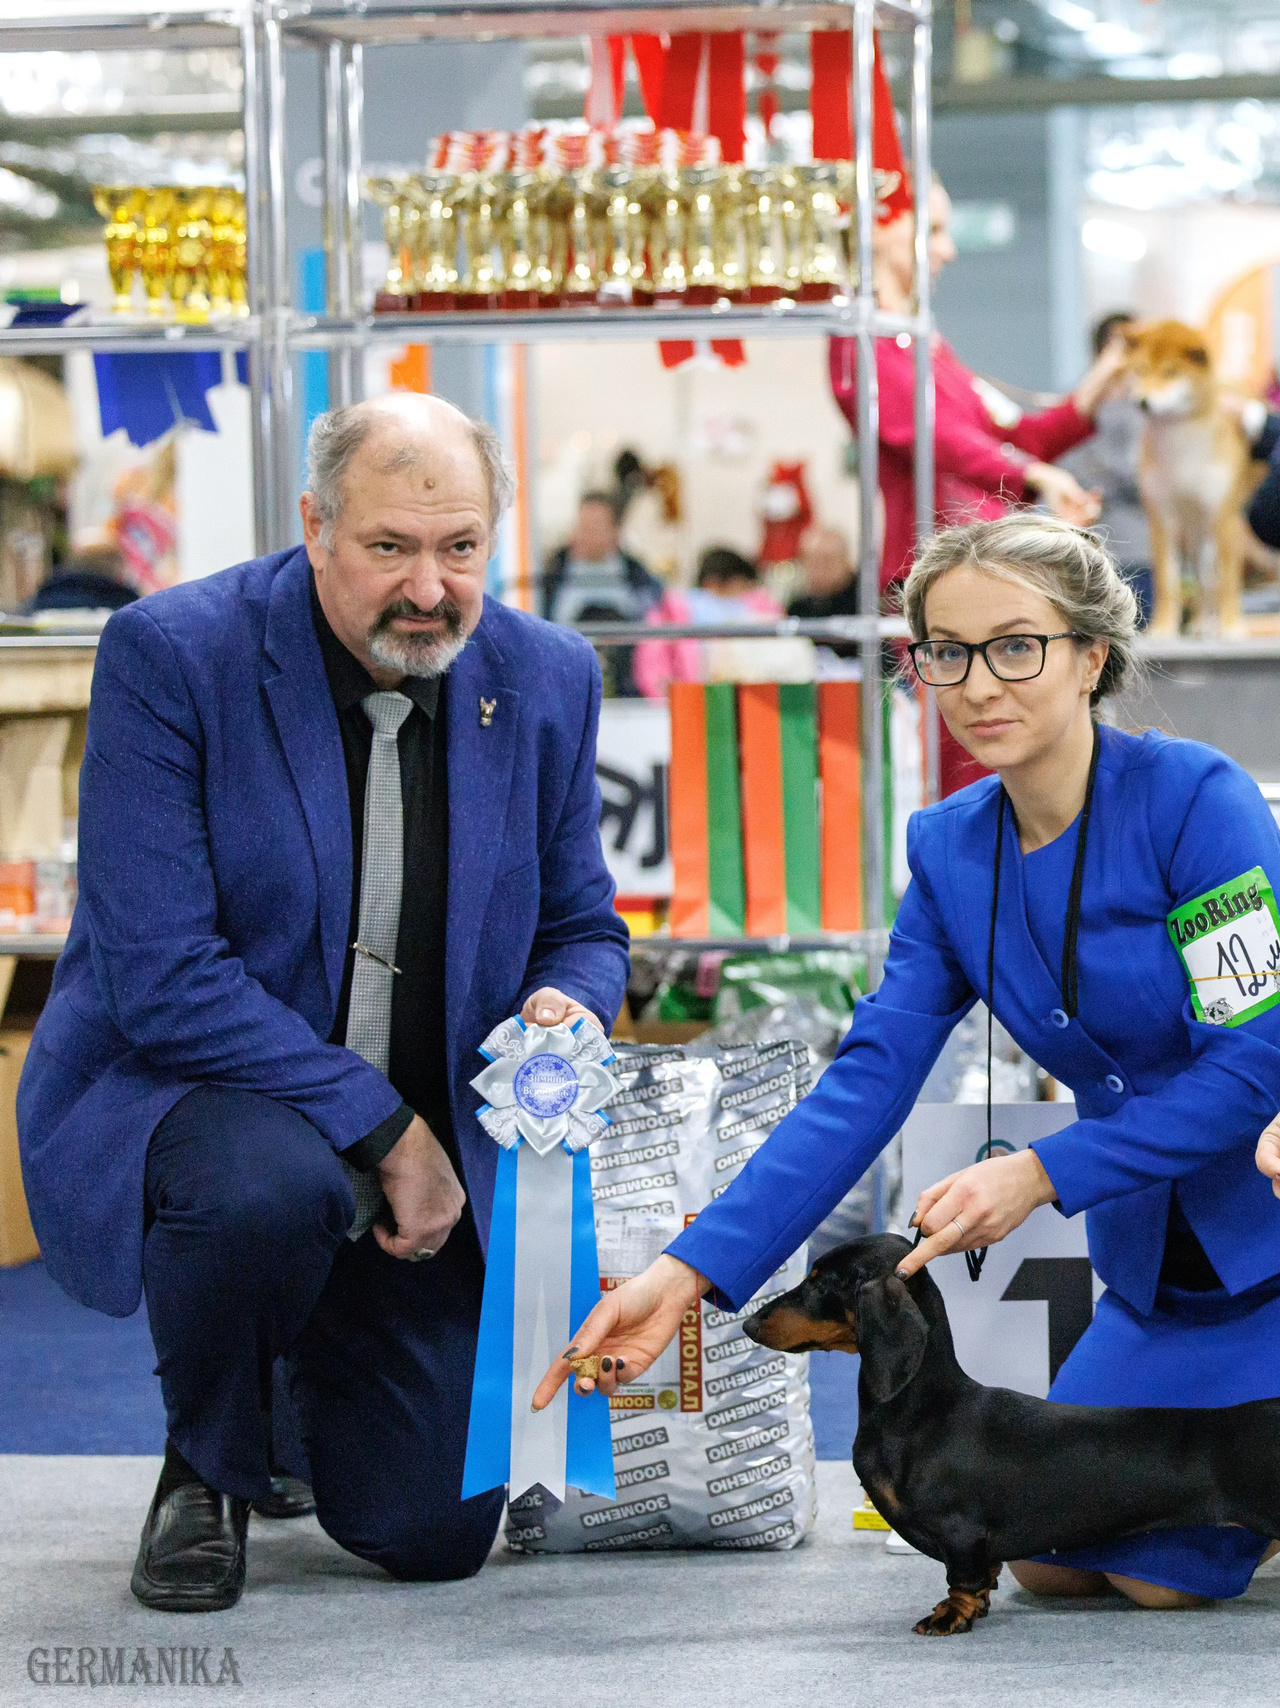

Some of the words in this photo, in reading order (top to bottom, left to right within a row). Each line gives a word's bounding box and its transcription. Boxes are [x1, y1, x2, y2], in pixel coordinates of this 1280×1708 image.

[1170, 883, 1265, 945] ZooRing
[590, 1142, 678, 1171] ЗООМЕНЮ
[681, 1302, 700, 1410] СИОНАЛ
[707, 1358, 786, 1395] ЗООМЕНЮ
[609, 1396, 654, 1408] ЗООМ
[708, 1390, 787, 1428] ЗООМЕНЮ
[612, 1430, 667, 1455] ЗООМЕ
[708, 1423, 788, 1461] ЗООМЕНЮ
[709, 1456, 790, 1494] ЗООМЕНЮ
[583, 1496, 669, 1527] ЗООМЕНЮ
[710, 1489, 792, 1527] ЗООМЕНЮ
